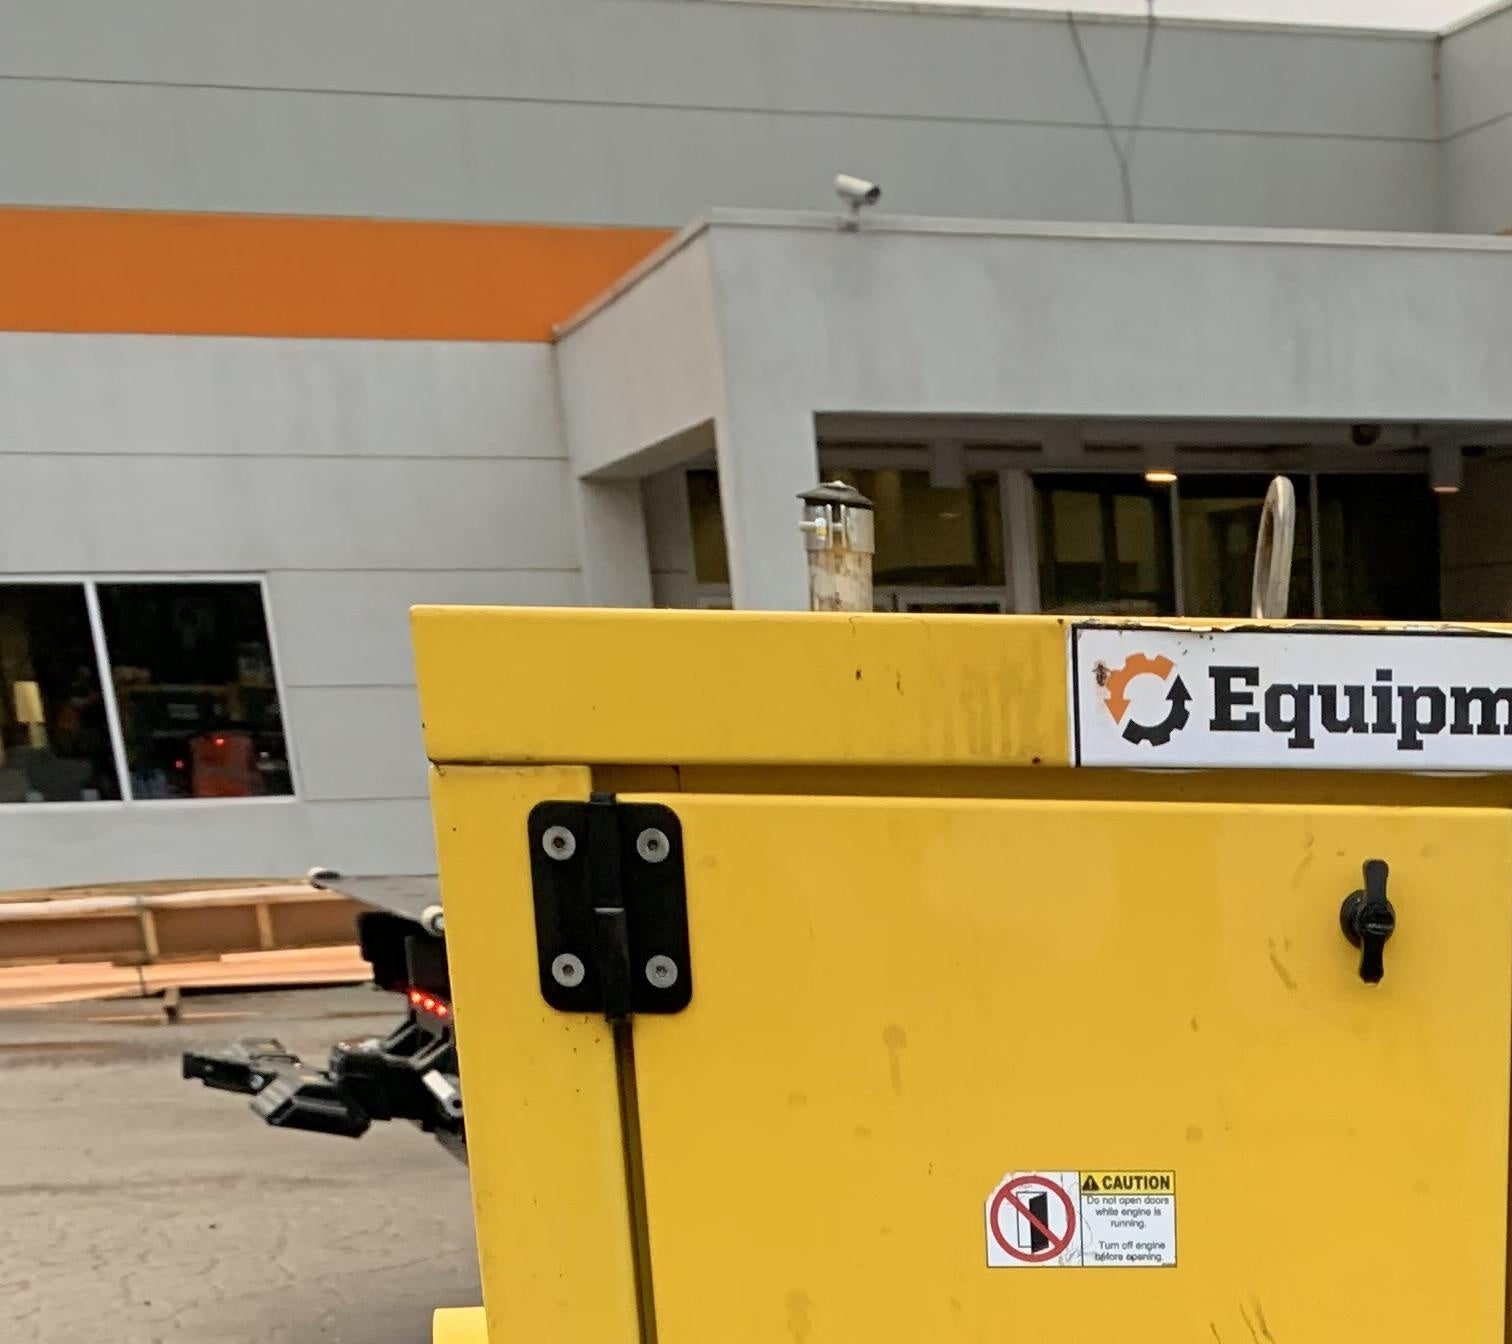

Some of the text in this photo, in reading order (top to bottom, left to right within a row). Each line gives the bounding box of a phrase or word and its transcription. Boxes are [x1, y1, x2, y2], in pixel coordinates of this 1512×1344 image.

[1102, 1175, 1170, 1190] CAUTION
[1087, 1196, 1170, 1206] Do not open doors
[1096, 1207, 1161, 1218] while engine is
[1099, 1241, 1165, 1252] Turn off engine
[1095, 1252, 1123, 1261] before
